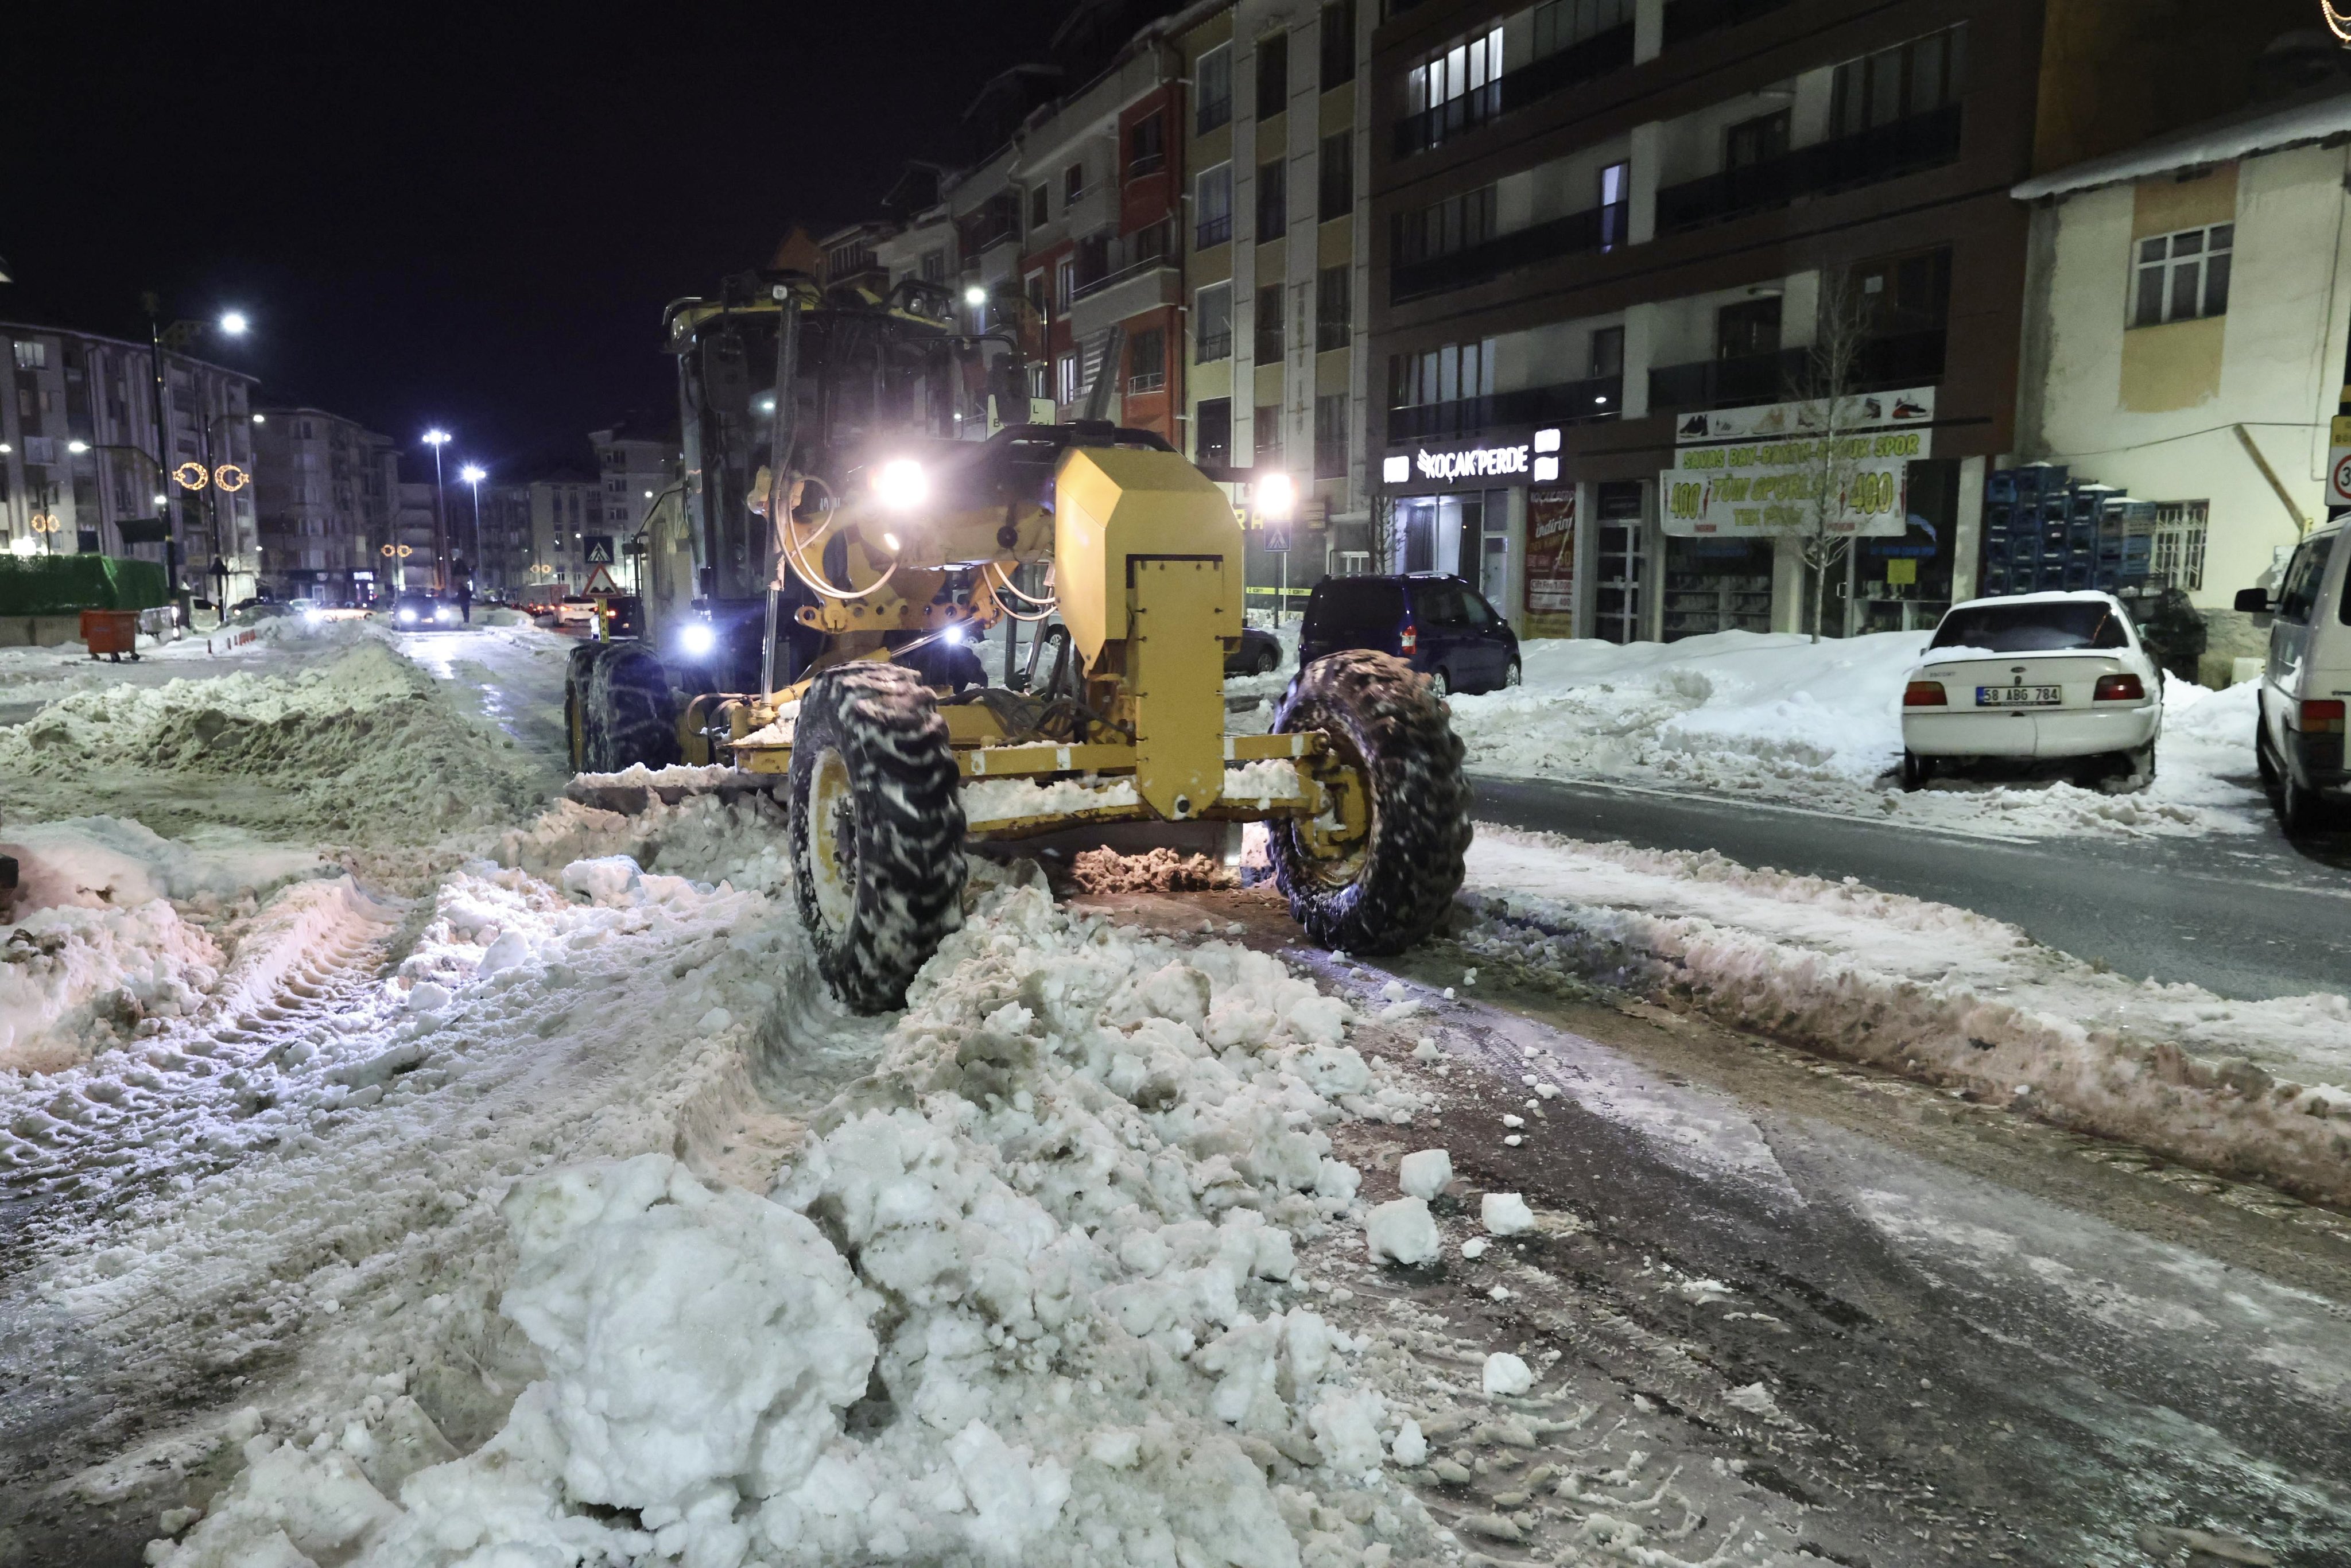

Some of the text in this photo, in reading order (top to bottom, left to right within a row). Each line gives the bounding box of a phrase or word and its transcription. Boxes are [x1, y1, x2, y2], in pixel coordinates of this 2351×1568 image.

[1875, 433, 1920, 458] SPOR
[1426, 445, 1528, 484] KOÇAK PERDE
[2341, 466, 2351, 487] 3
[1671, 482, 1701, 519] 400
[1849, 472, 1894, 514] 400
[1984, 689, 1999, 701] 58
[2035, 688, 2058, 700] 784
